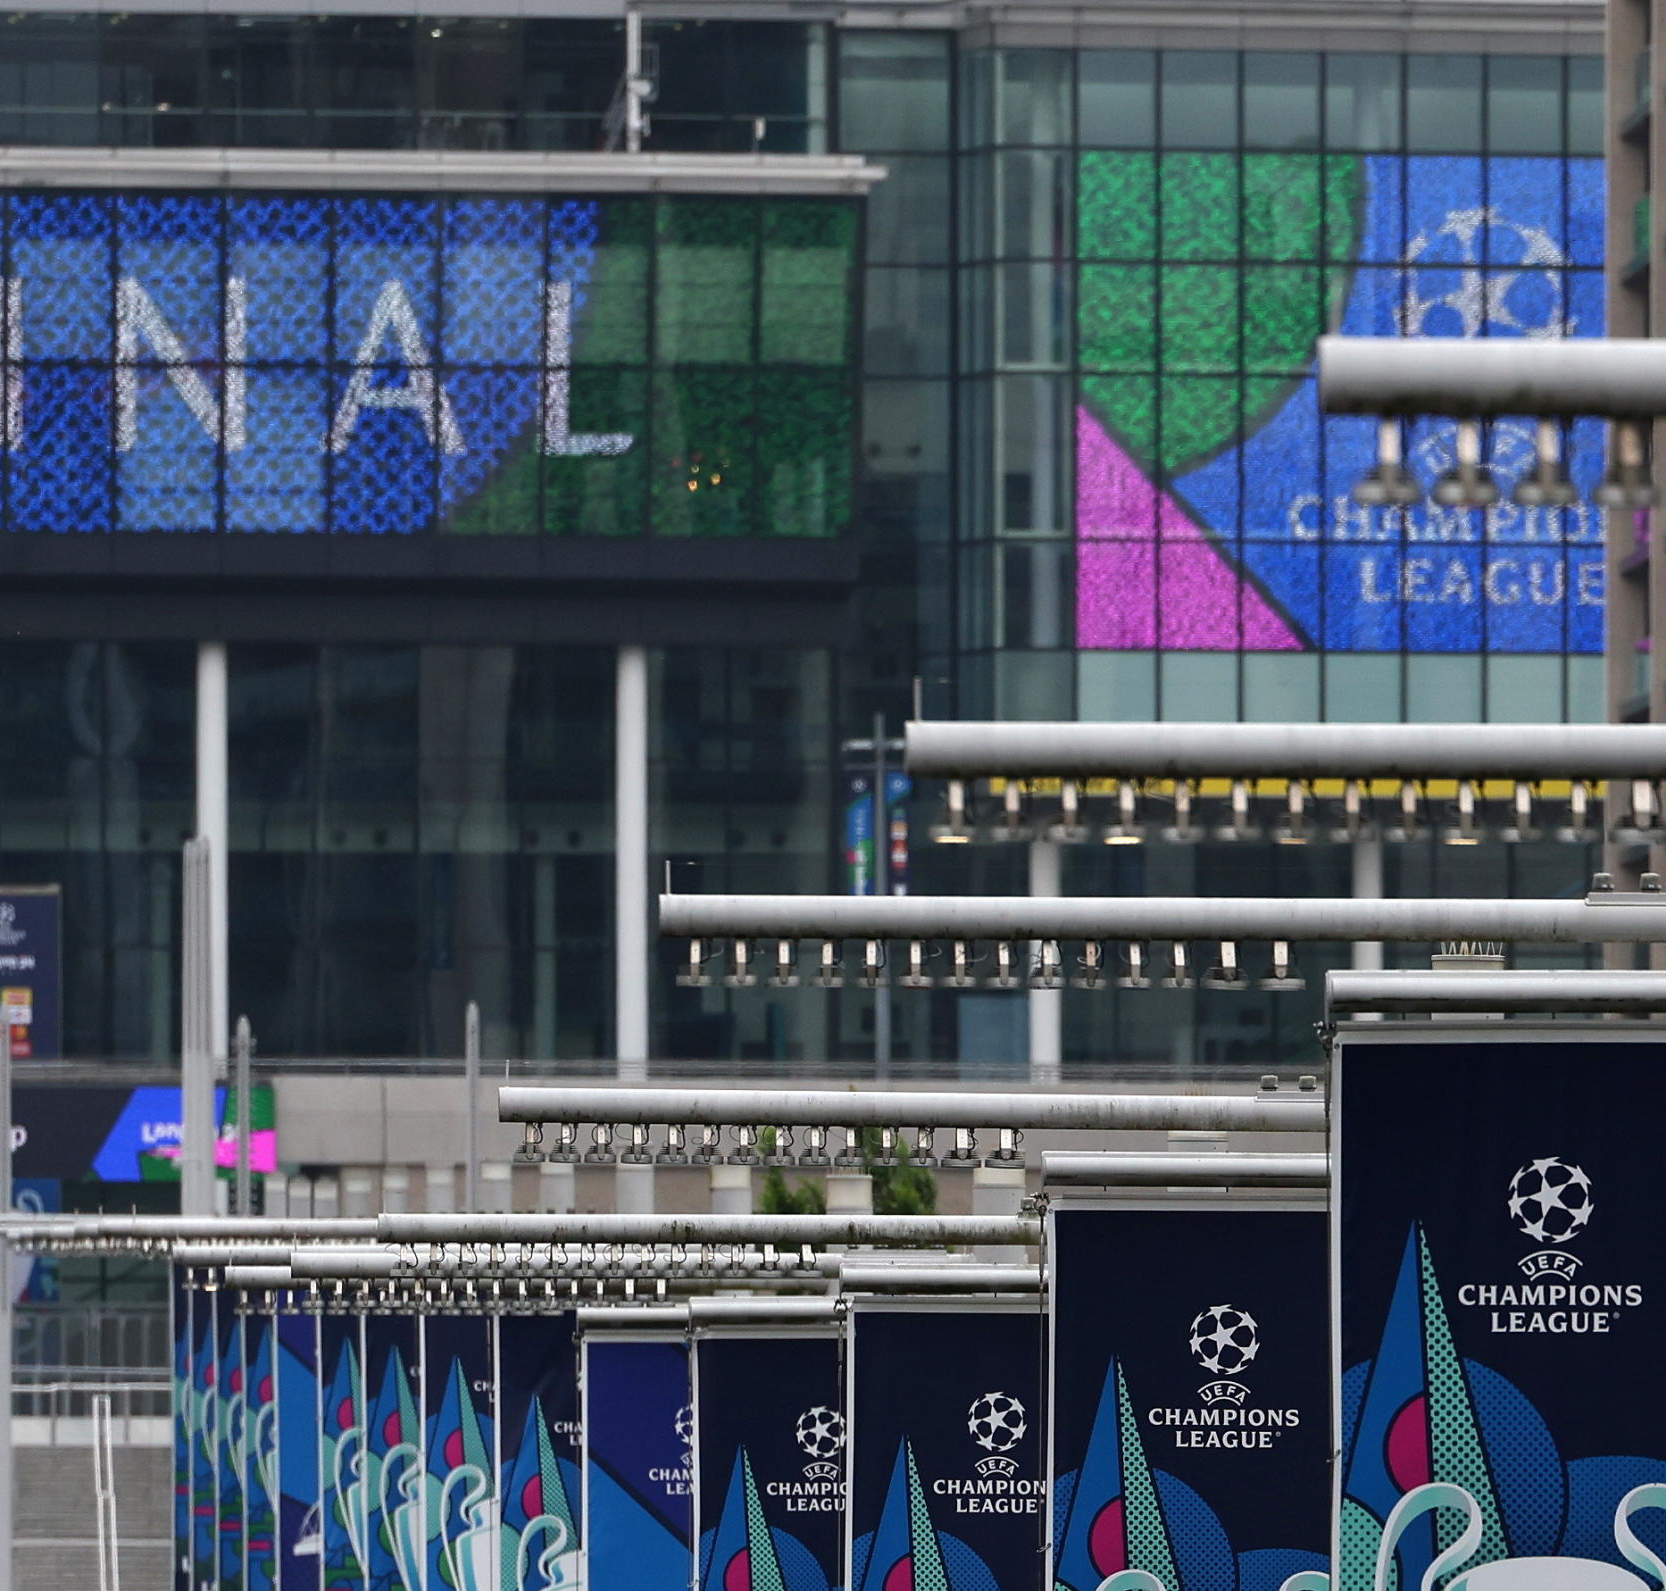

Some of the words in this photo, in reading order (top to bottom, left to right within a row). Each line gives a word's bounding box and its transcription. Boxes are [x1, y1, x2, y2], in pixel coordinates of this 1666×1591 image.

[1289, 496, 1607, 543] CHAMPIO
[1521, 1255, 1577, 1277] UEFA
[1457, 1283, 1643, 1307] CHAMPIONS
[1490, 1311, 1610, 1333] LEAGUE
[1200, 1384, 1247, 1403] UEFA
[1147, 1407, 1300, 1428] CHAMPIONS
[1174, 1430, 1274, 1449] LEAGUE
[804, 1467, 838, 1479] UEFA
[978, 1460, 1015, 1477] UEFA
[766, 1482, 848, 1496] CHAMPI
[933, 1479, 1047, 1495] CHAMPION
[786, 1498, 847, 1512] LEAGU
[956, 1499, 1038, 1514] LEAGUE
